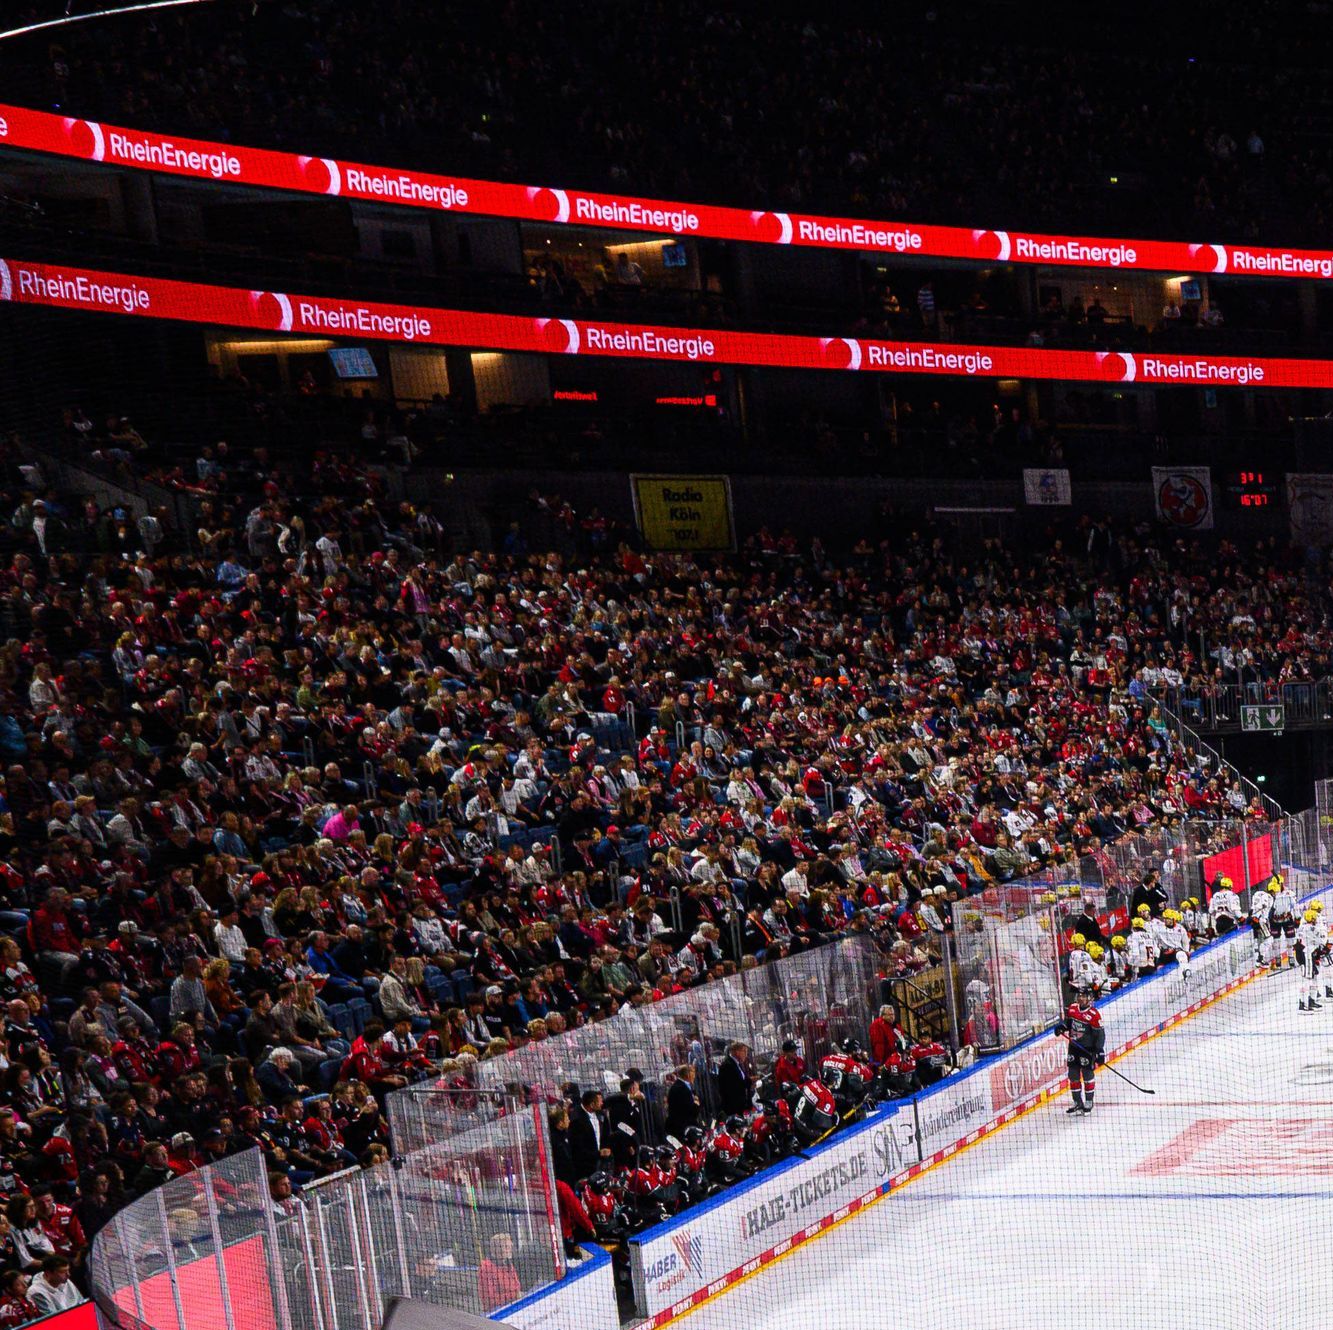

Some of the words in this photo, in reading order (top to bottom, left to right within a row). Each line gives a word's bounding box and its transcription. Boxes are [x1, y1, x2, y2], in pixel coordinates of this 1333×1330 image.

[110, 132, 240, 176] RheinEnergie
[347, 169, 468, 206] RheinEnergie
[576, 198, 699, 231] RheinEnergie
[799, 221, 922, 252] RheinEnergie
[1017, 240, 1137, 266] RheinEnergie
[19, 269, 149, 312] RheinEnergie
[300, 303, 431, 340] RheinEnergie
[586, 329, 714, 360] RheinEnergie
[869, 347, 992, 373] RheinEnergie
[1143, 359, 1264, 384] RheinEnergie
[663, 488, 703, 502] Radio
[670, 507, 701, 521] Köln
[746, 1152, 868, 1237] HAIE-TICKETS.DE
